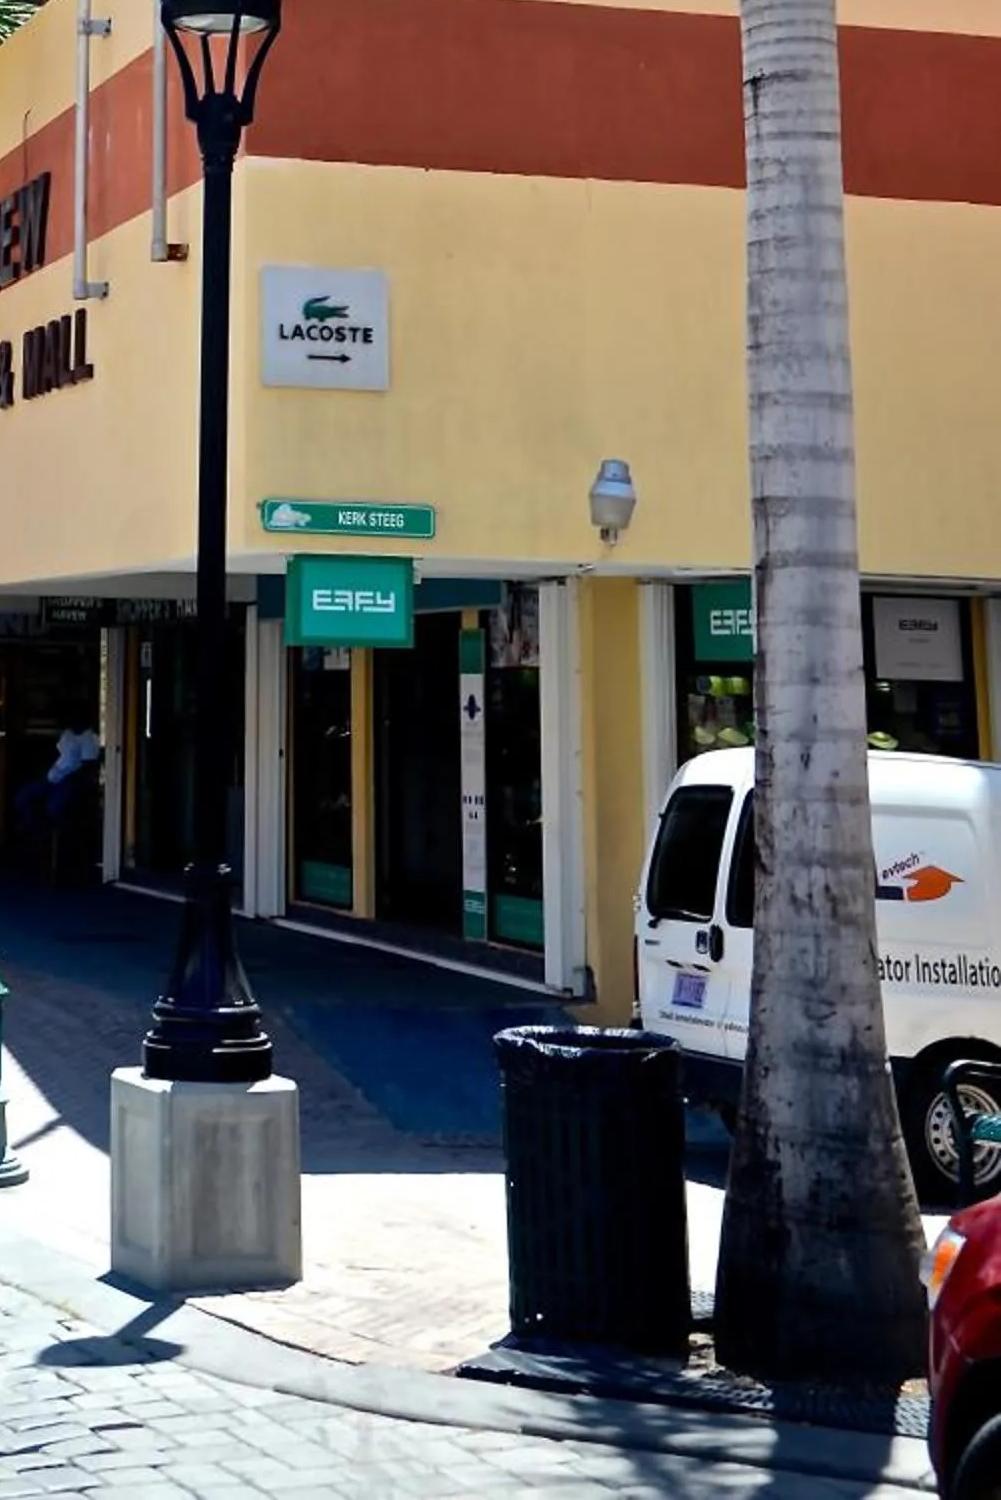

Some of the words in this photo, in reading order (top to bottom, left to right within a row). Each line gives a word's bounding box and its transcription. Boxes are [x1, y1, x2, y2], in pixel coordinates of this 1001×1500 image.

[279, 323, 374, 344] LACOSTE
[22, 308, 94, 400] MALL
[338, 510, 366, 527] KERK
[368, 511, 405, 528] STEEG
[879, 955, 911, 982] ator
[914, 953, 1001, 988] Installatio
